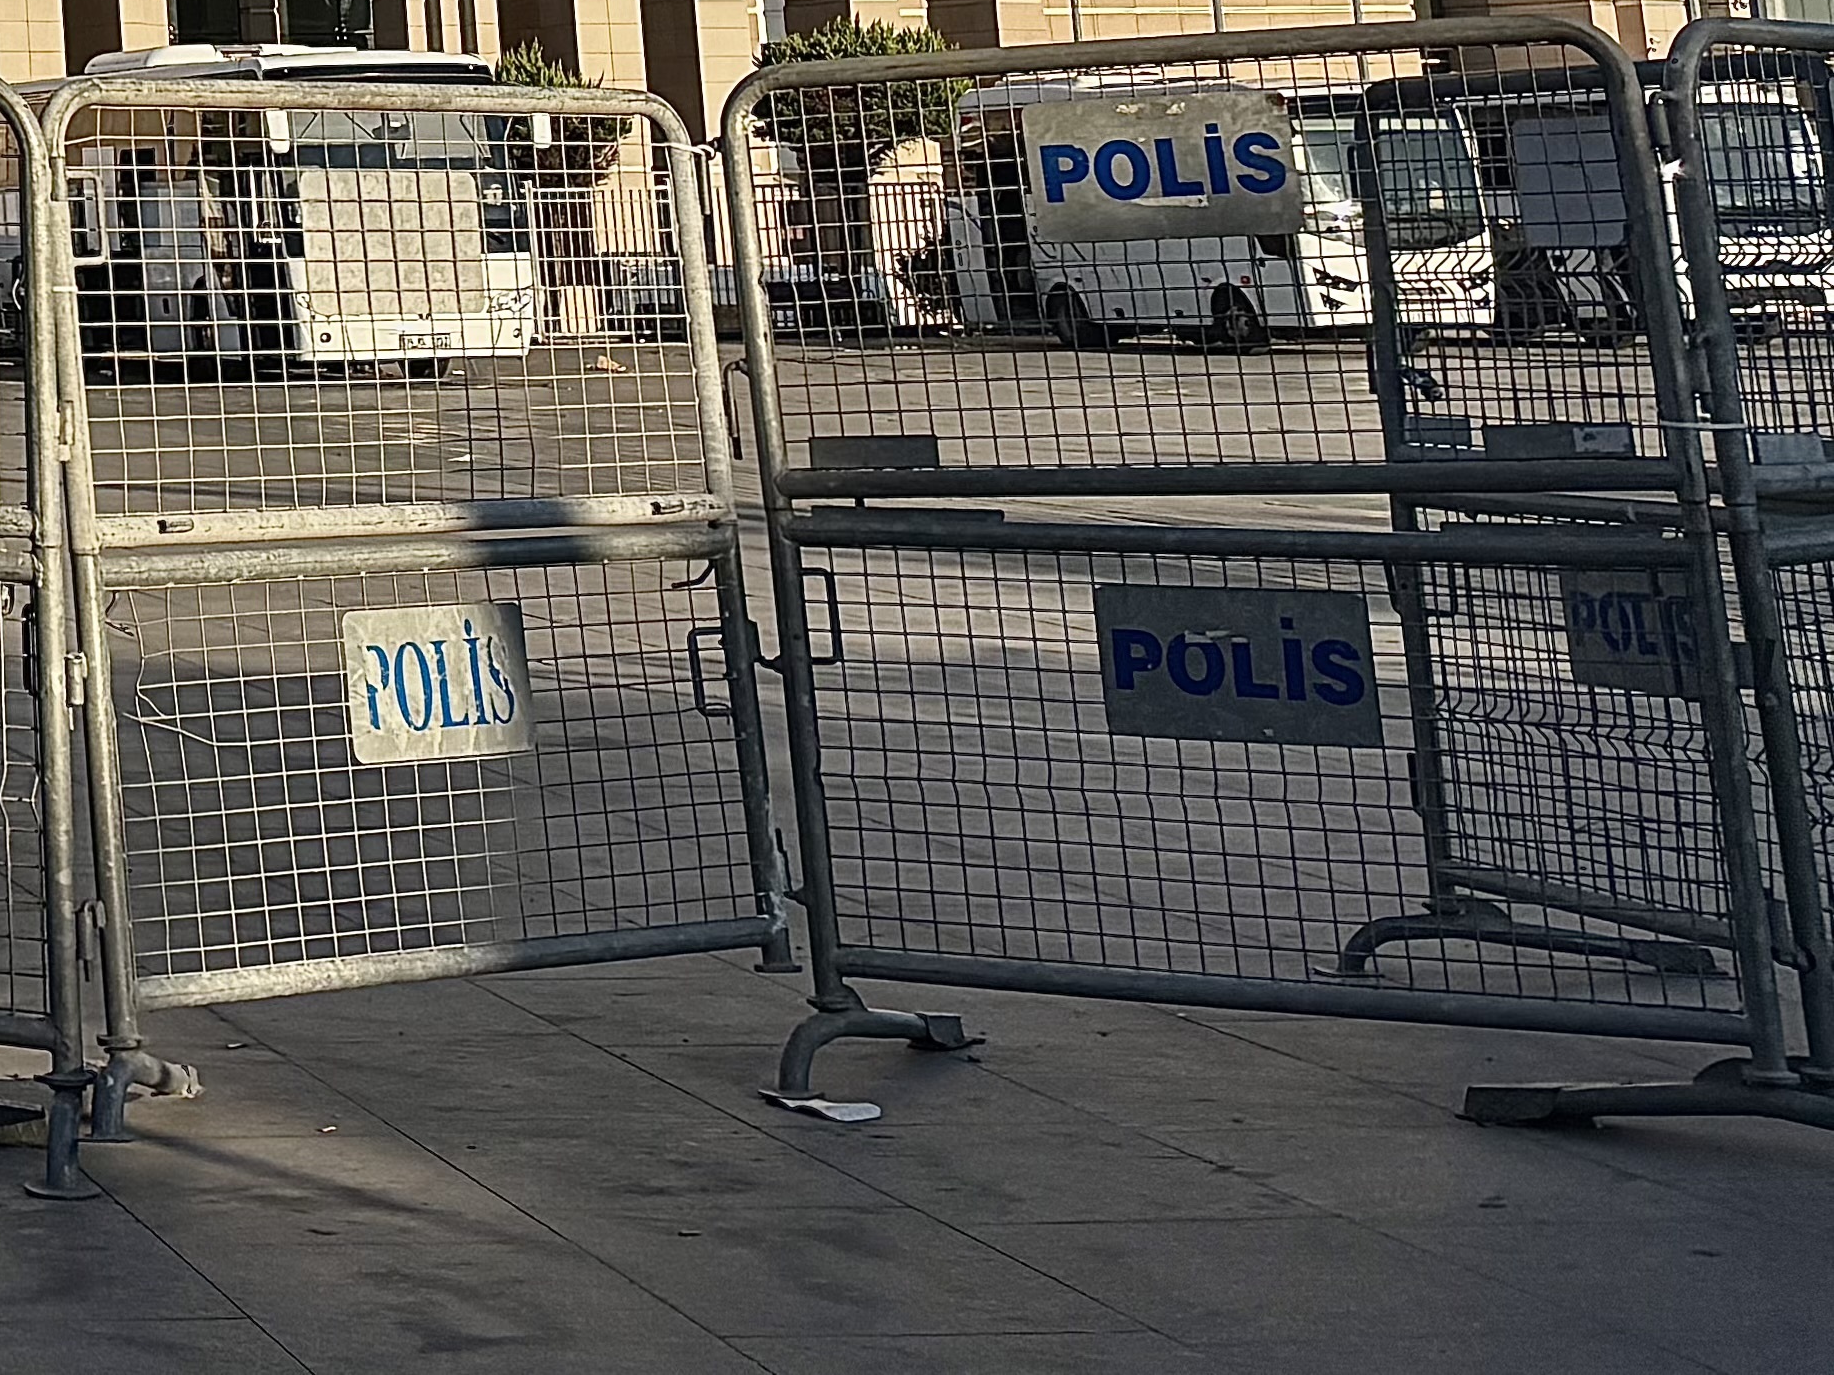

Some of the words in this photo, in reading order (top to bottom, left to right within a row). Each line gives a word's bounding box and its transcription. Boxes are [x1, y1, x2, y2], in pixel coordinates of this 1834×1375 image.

[1038, 121, 1287, 204] POLİS
[364, 617, 517, 732] POLİS
[1110, 616, 1366, 706] POLİS
